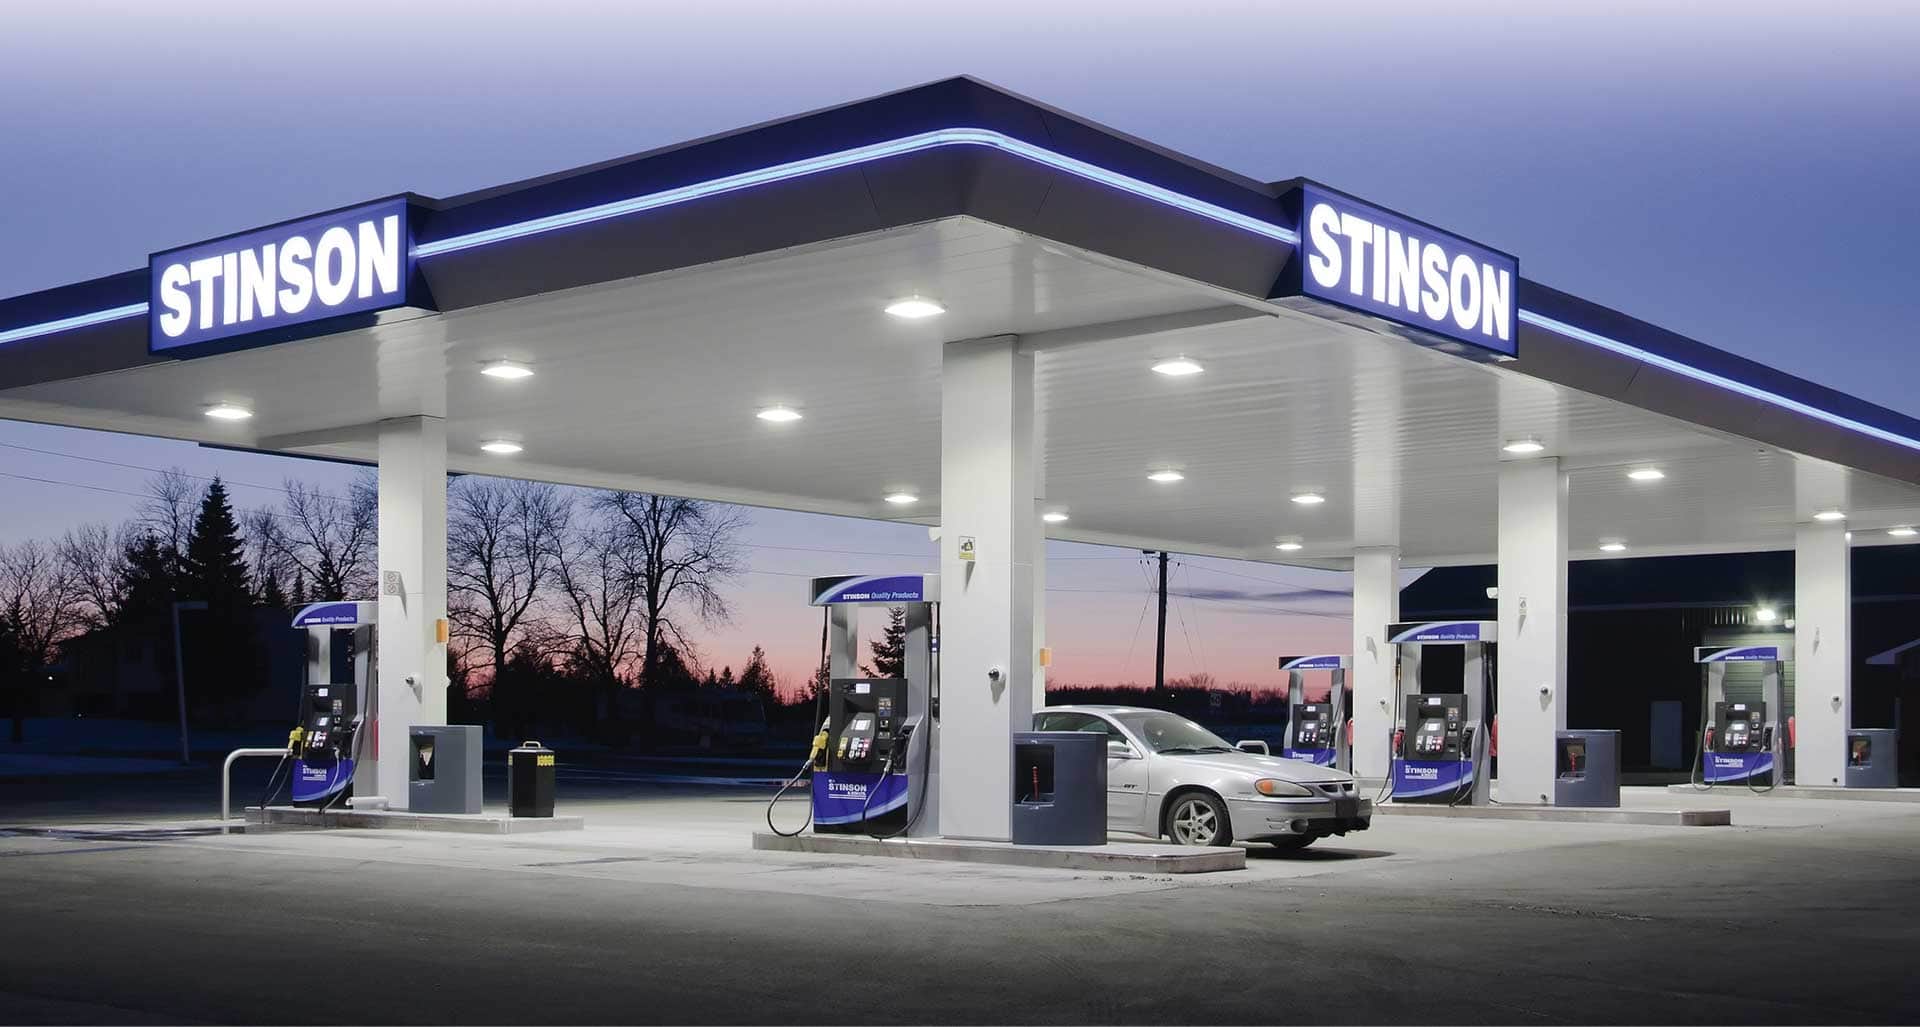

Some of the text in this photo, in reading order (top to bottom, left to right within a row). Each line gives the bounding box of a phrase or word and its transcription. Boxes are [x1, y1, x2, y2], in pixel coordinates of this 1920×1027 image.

[159, 214, 399, 337] STINSON
[1309, 203, 1510, 341] STINSON
[871, 592, 891, 600] Quality
[828, 783, 867, 792] STINSON
